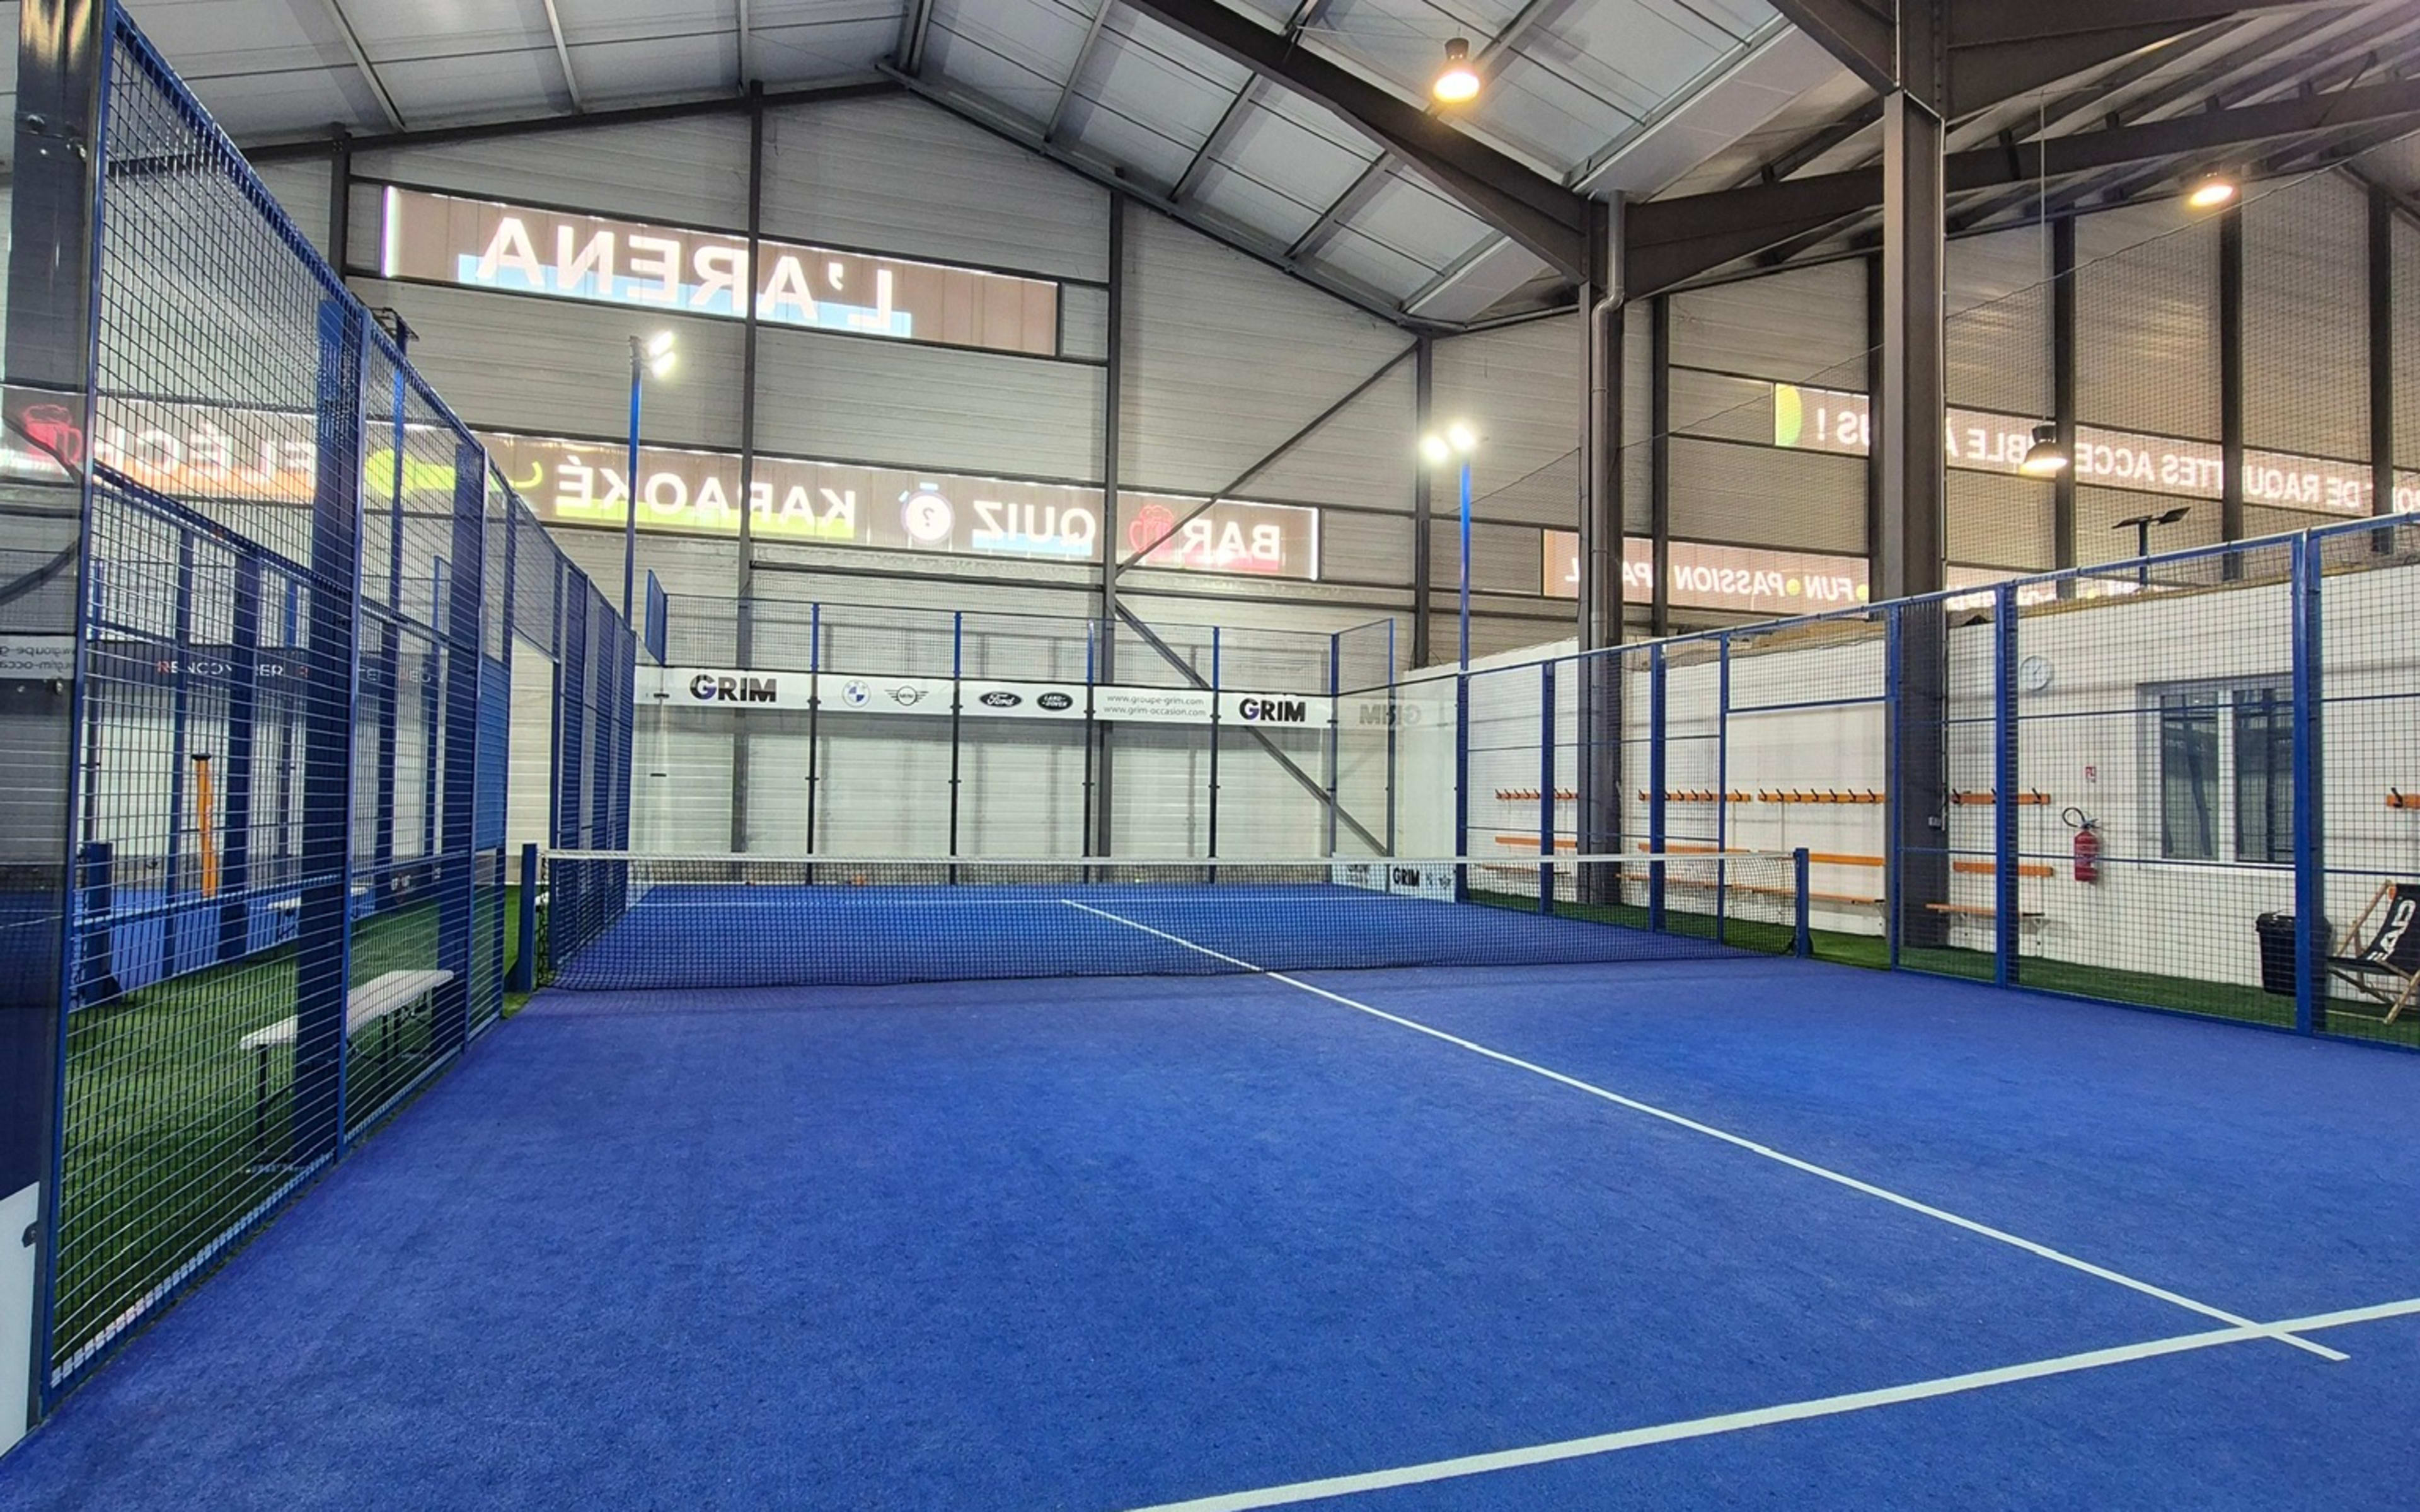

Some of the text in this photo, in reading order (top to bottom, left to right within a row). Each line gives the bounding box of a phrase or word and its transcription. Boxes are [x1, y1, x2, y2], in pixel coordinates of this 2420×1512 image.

[689, 674, 777, 702] GRIM
[1107, 694, 1204, 706] www.groupe-grim.com
[1239, 698, 1306, 722] GRIM
[1103, 706, 1206, 717] www.grim-occasion.com
[1393, 867, 1420, 887] GRIM
